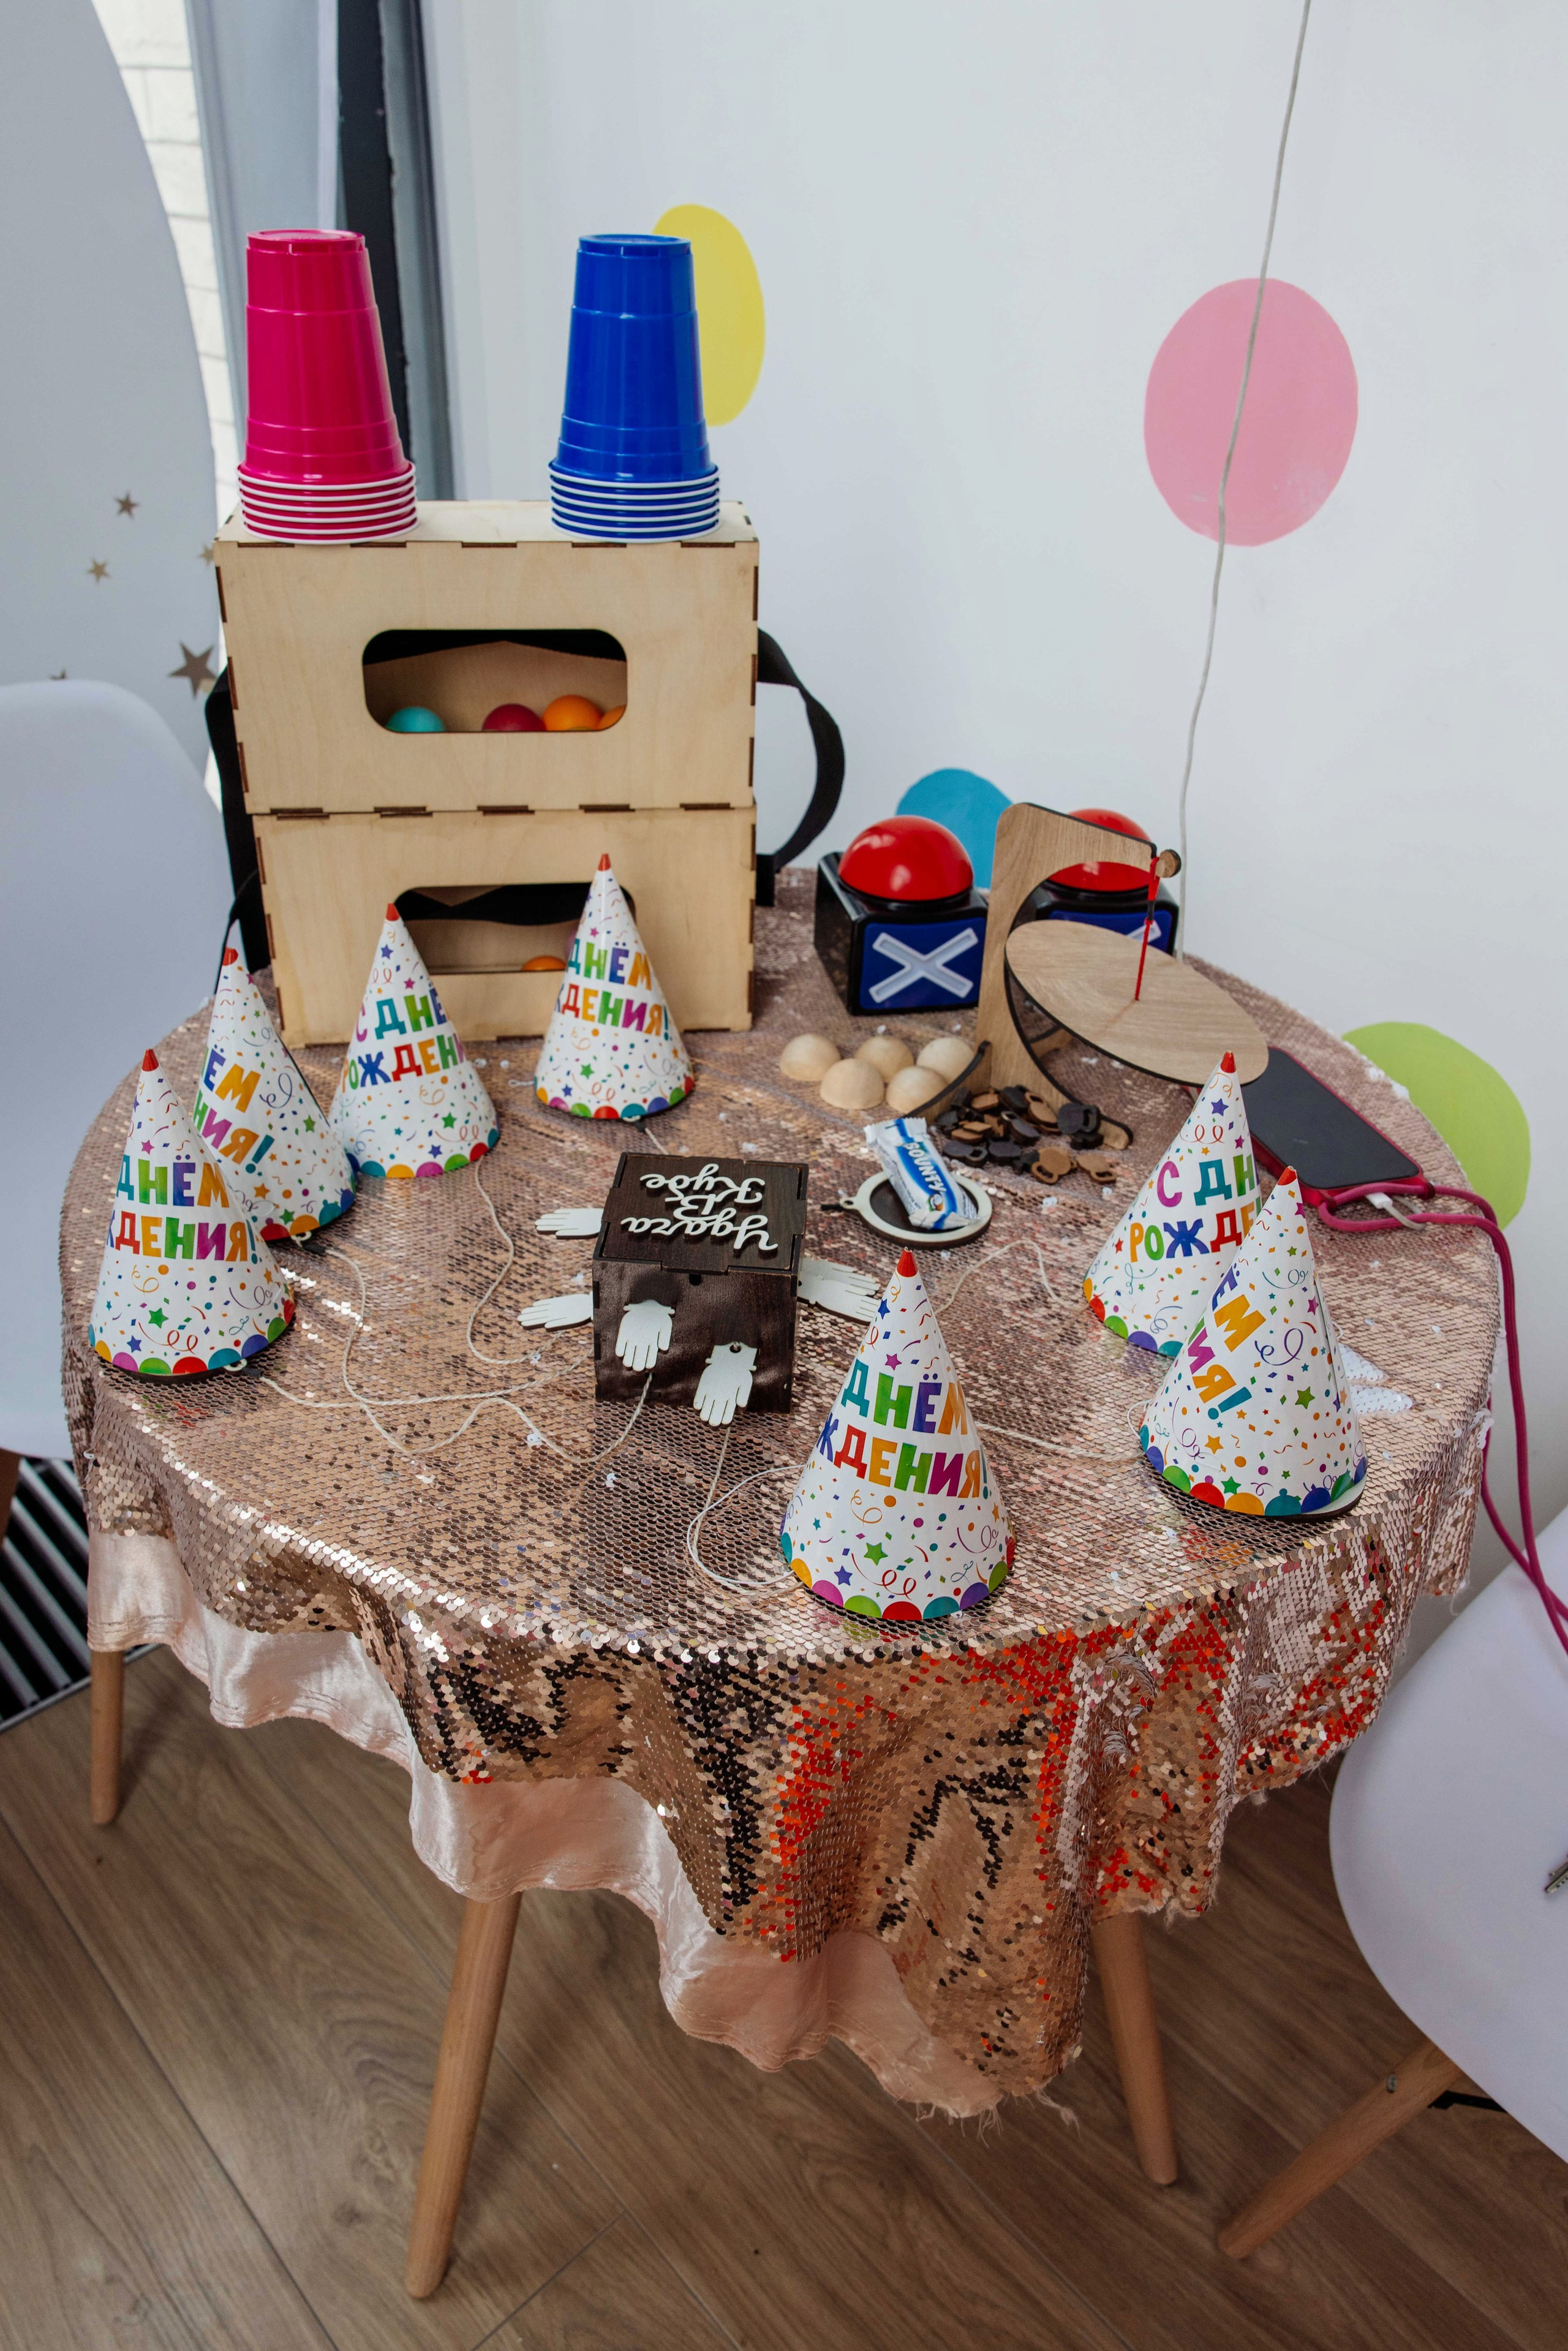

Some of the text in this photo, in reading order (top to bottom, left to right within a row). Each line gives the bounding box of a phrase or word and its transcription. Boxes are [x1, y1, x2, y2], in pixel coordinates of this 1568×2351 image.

[375, 982, 451, 1040] ДНЁ
[202, 1044, 262, 1114] ЁМ
[639, 1163, 766, 1204] Кубе
[902, 1142, 947, 1192] BOUNTY
[1157, 1148, 1259, 1208] С ДН
[840, 1358, 968, 1436] ДНЁМ
